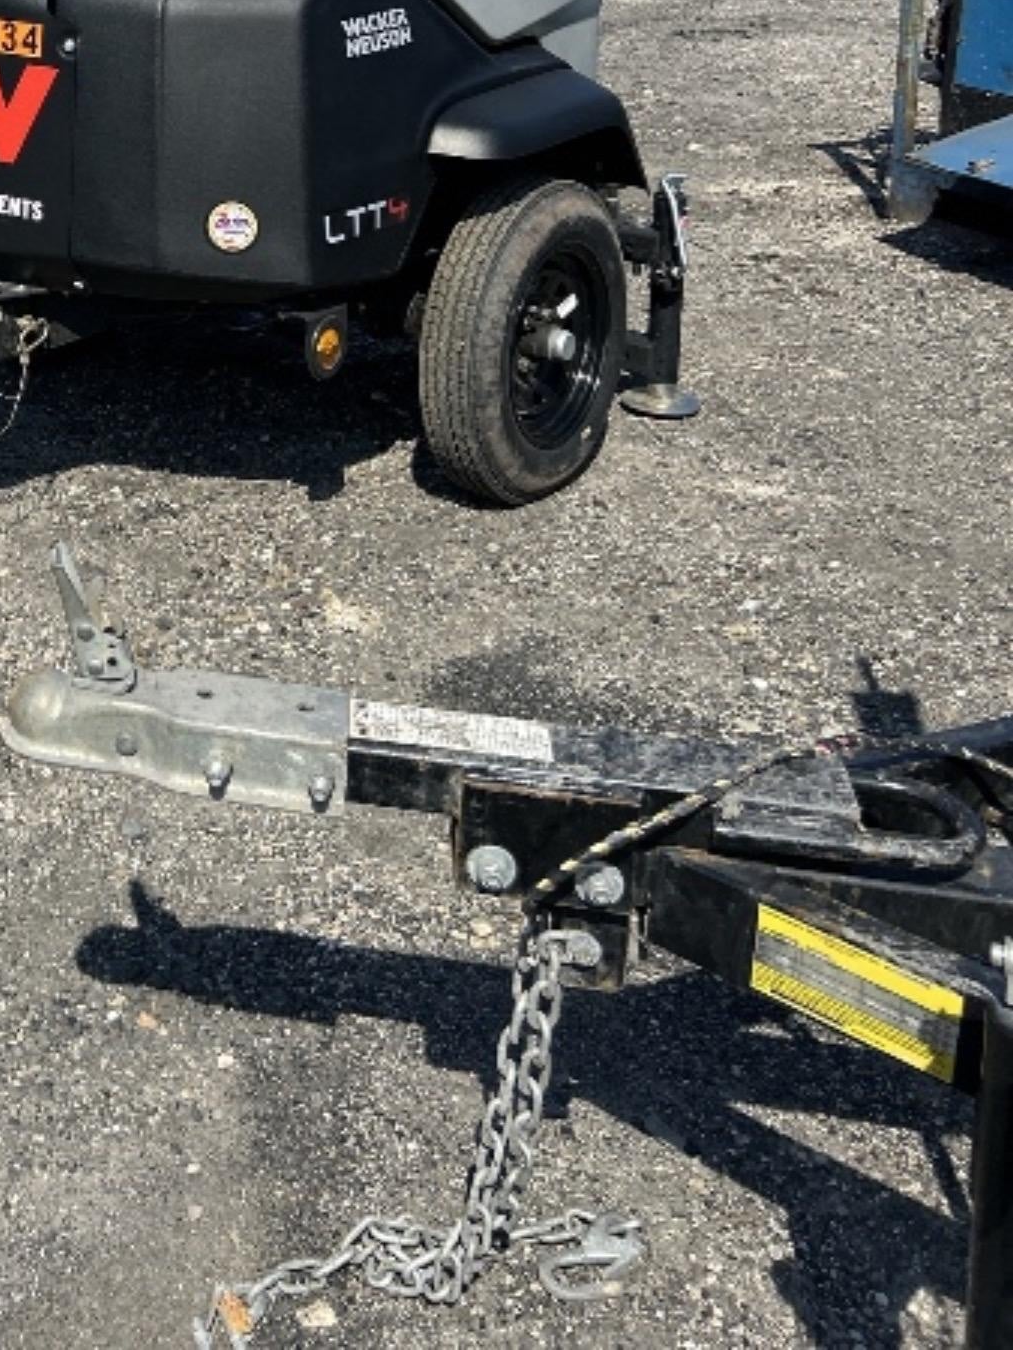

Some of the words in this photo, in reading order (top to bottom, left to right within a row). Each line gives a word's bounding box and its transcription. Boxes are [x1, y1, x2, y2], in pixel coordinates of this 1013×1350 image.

[340, 8, 409, 37] WACKER
[346, 26, 412, 58] NEUSON
[324, 199, 408, 245] LTT4
